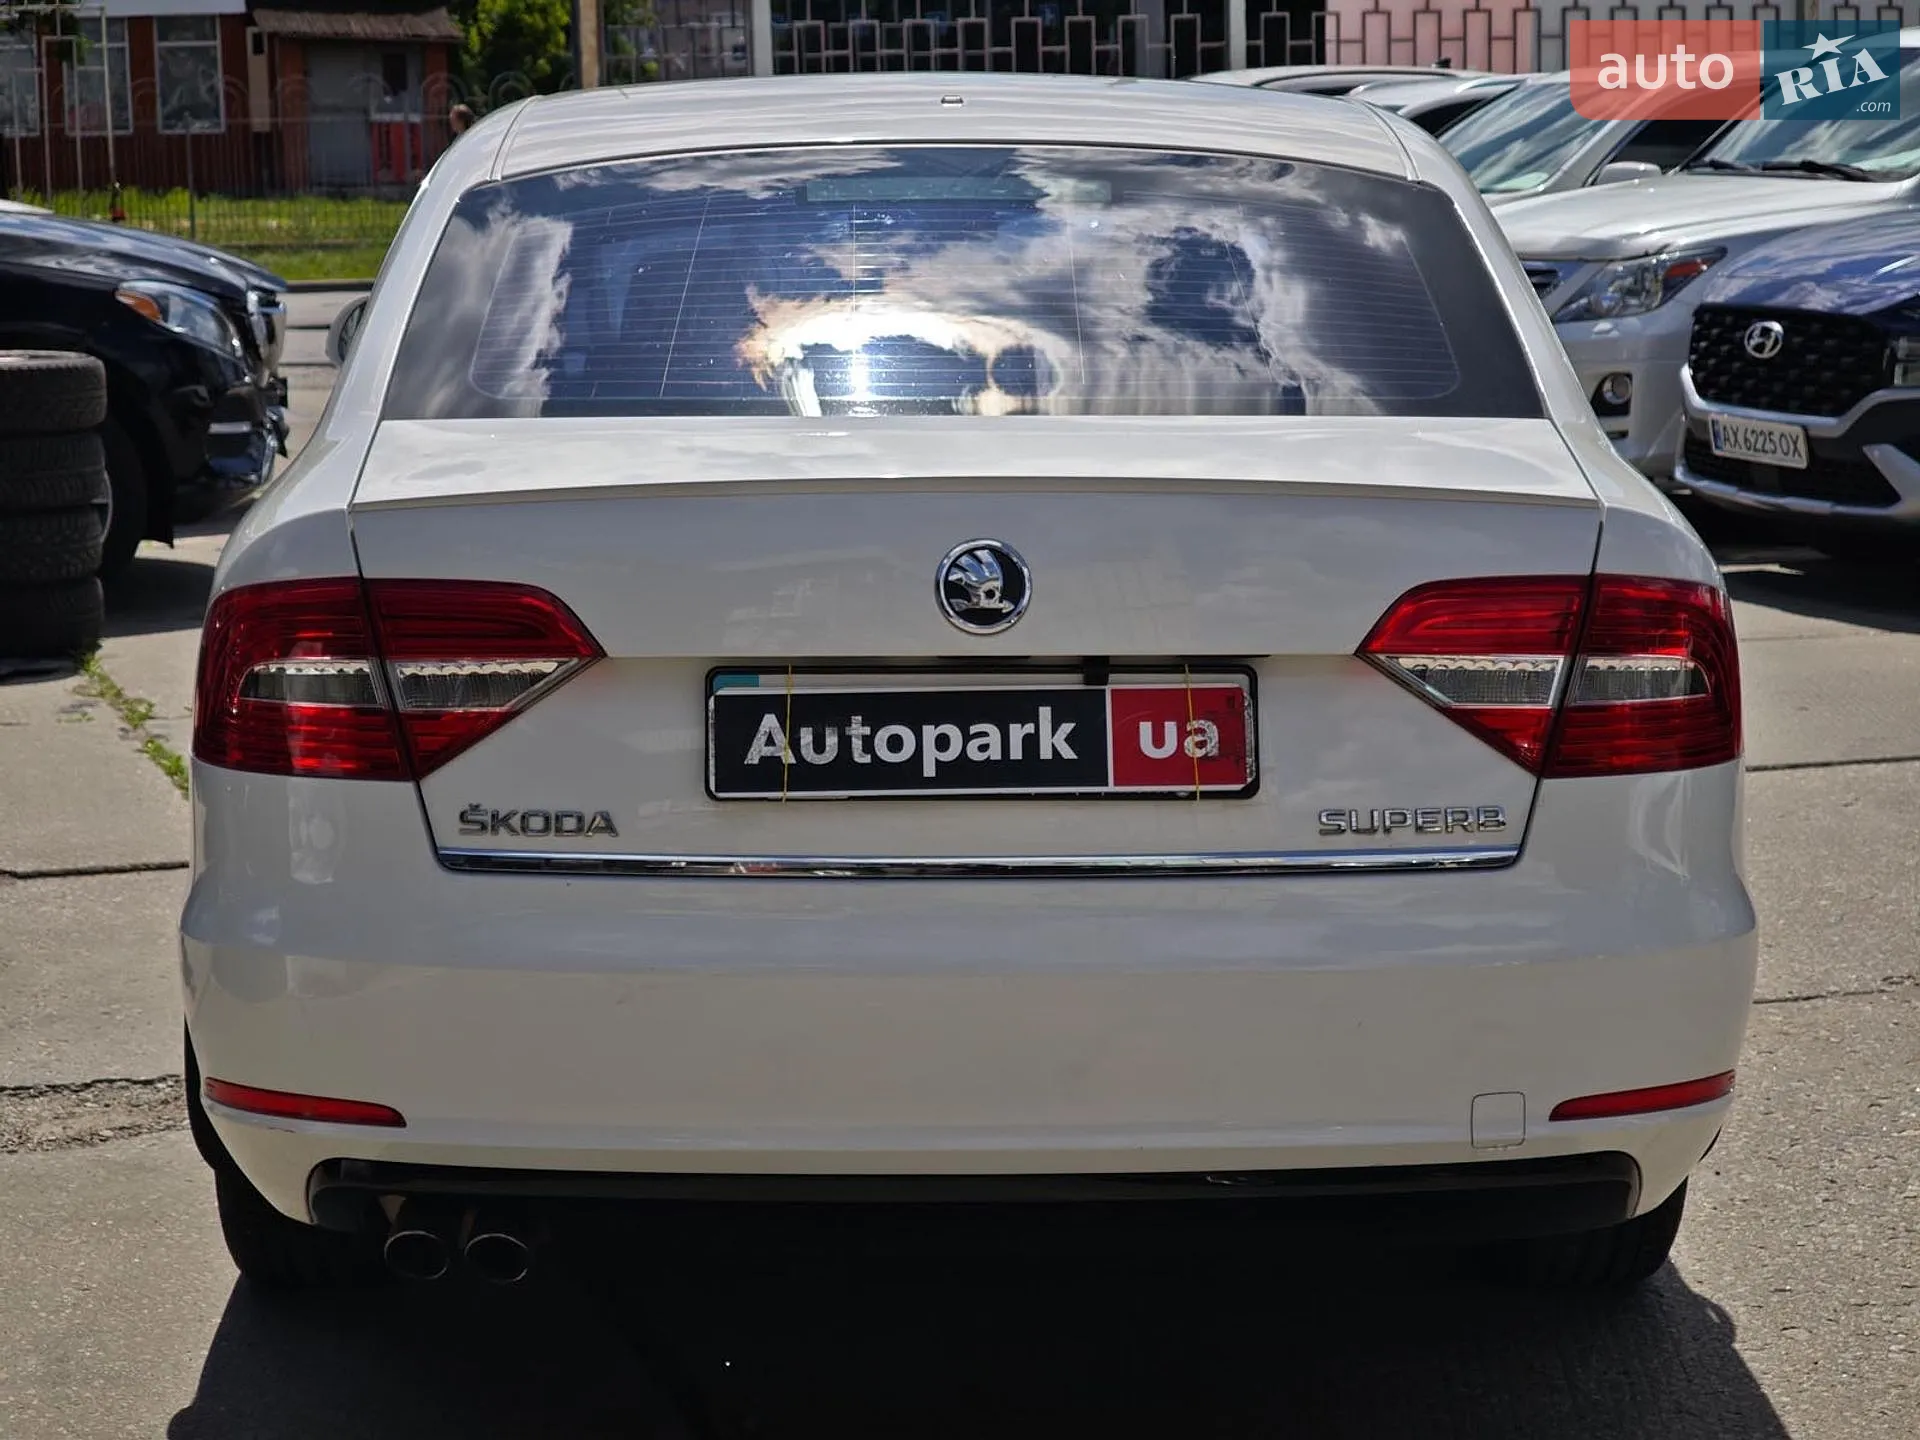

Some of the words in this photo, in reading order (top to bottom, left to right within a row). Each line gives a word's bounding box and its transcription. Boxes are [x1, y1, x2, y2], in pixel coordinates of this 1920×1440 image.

[1722, 424, 1742, 450] AX
[1743, 427, 1777, 454] 6225
[1779, 431, 1803, 458] OX
[744, 706, 1079, 777] Autopark
[1138, 719, 1220, 759] ua
[459, 803, 619, 838] ŠKODA
[1318, 805, 1507, 836] SUPERB
